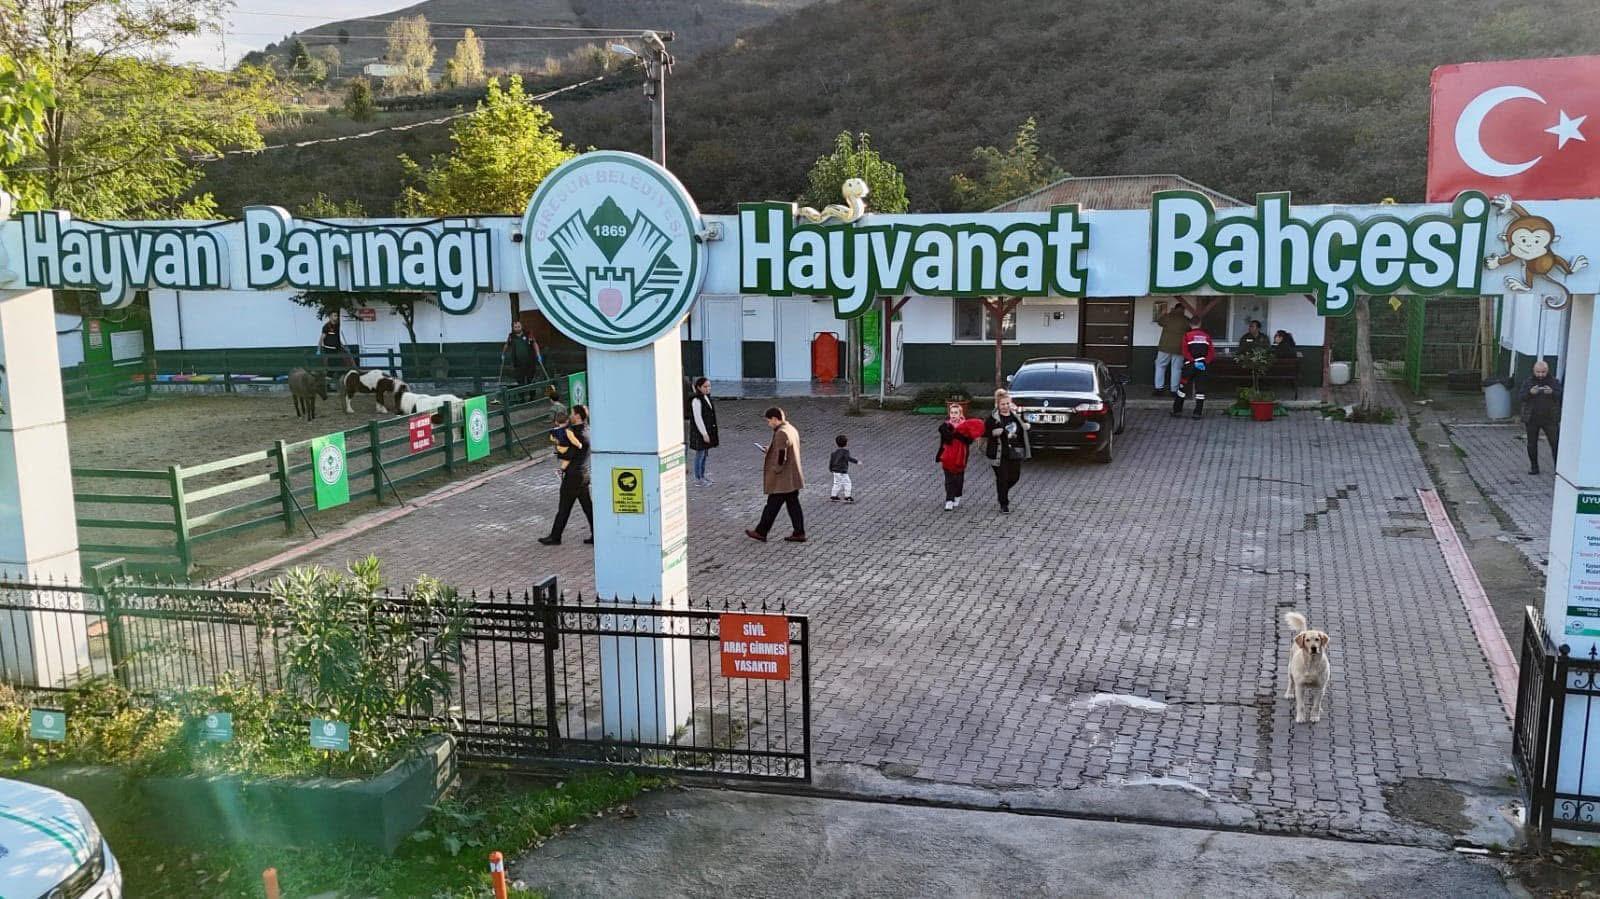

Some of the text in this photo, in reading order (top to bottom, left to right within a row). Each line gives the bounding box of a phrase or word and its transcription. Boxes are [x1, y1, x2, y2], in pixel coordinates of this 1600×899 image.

[593, 224, 627, 237] 1869
[22, 211, 219, 306] Hayvan
[740, 196, 1486, 314] Hayvanat Bahçesi
[743, 622, 766, 636] SİVİL
[724, 641, 747, 657] ARAÇ
[734, 660, 778, 673] YASAKTIR
